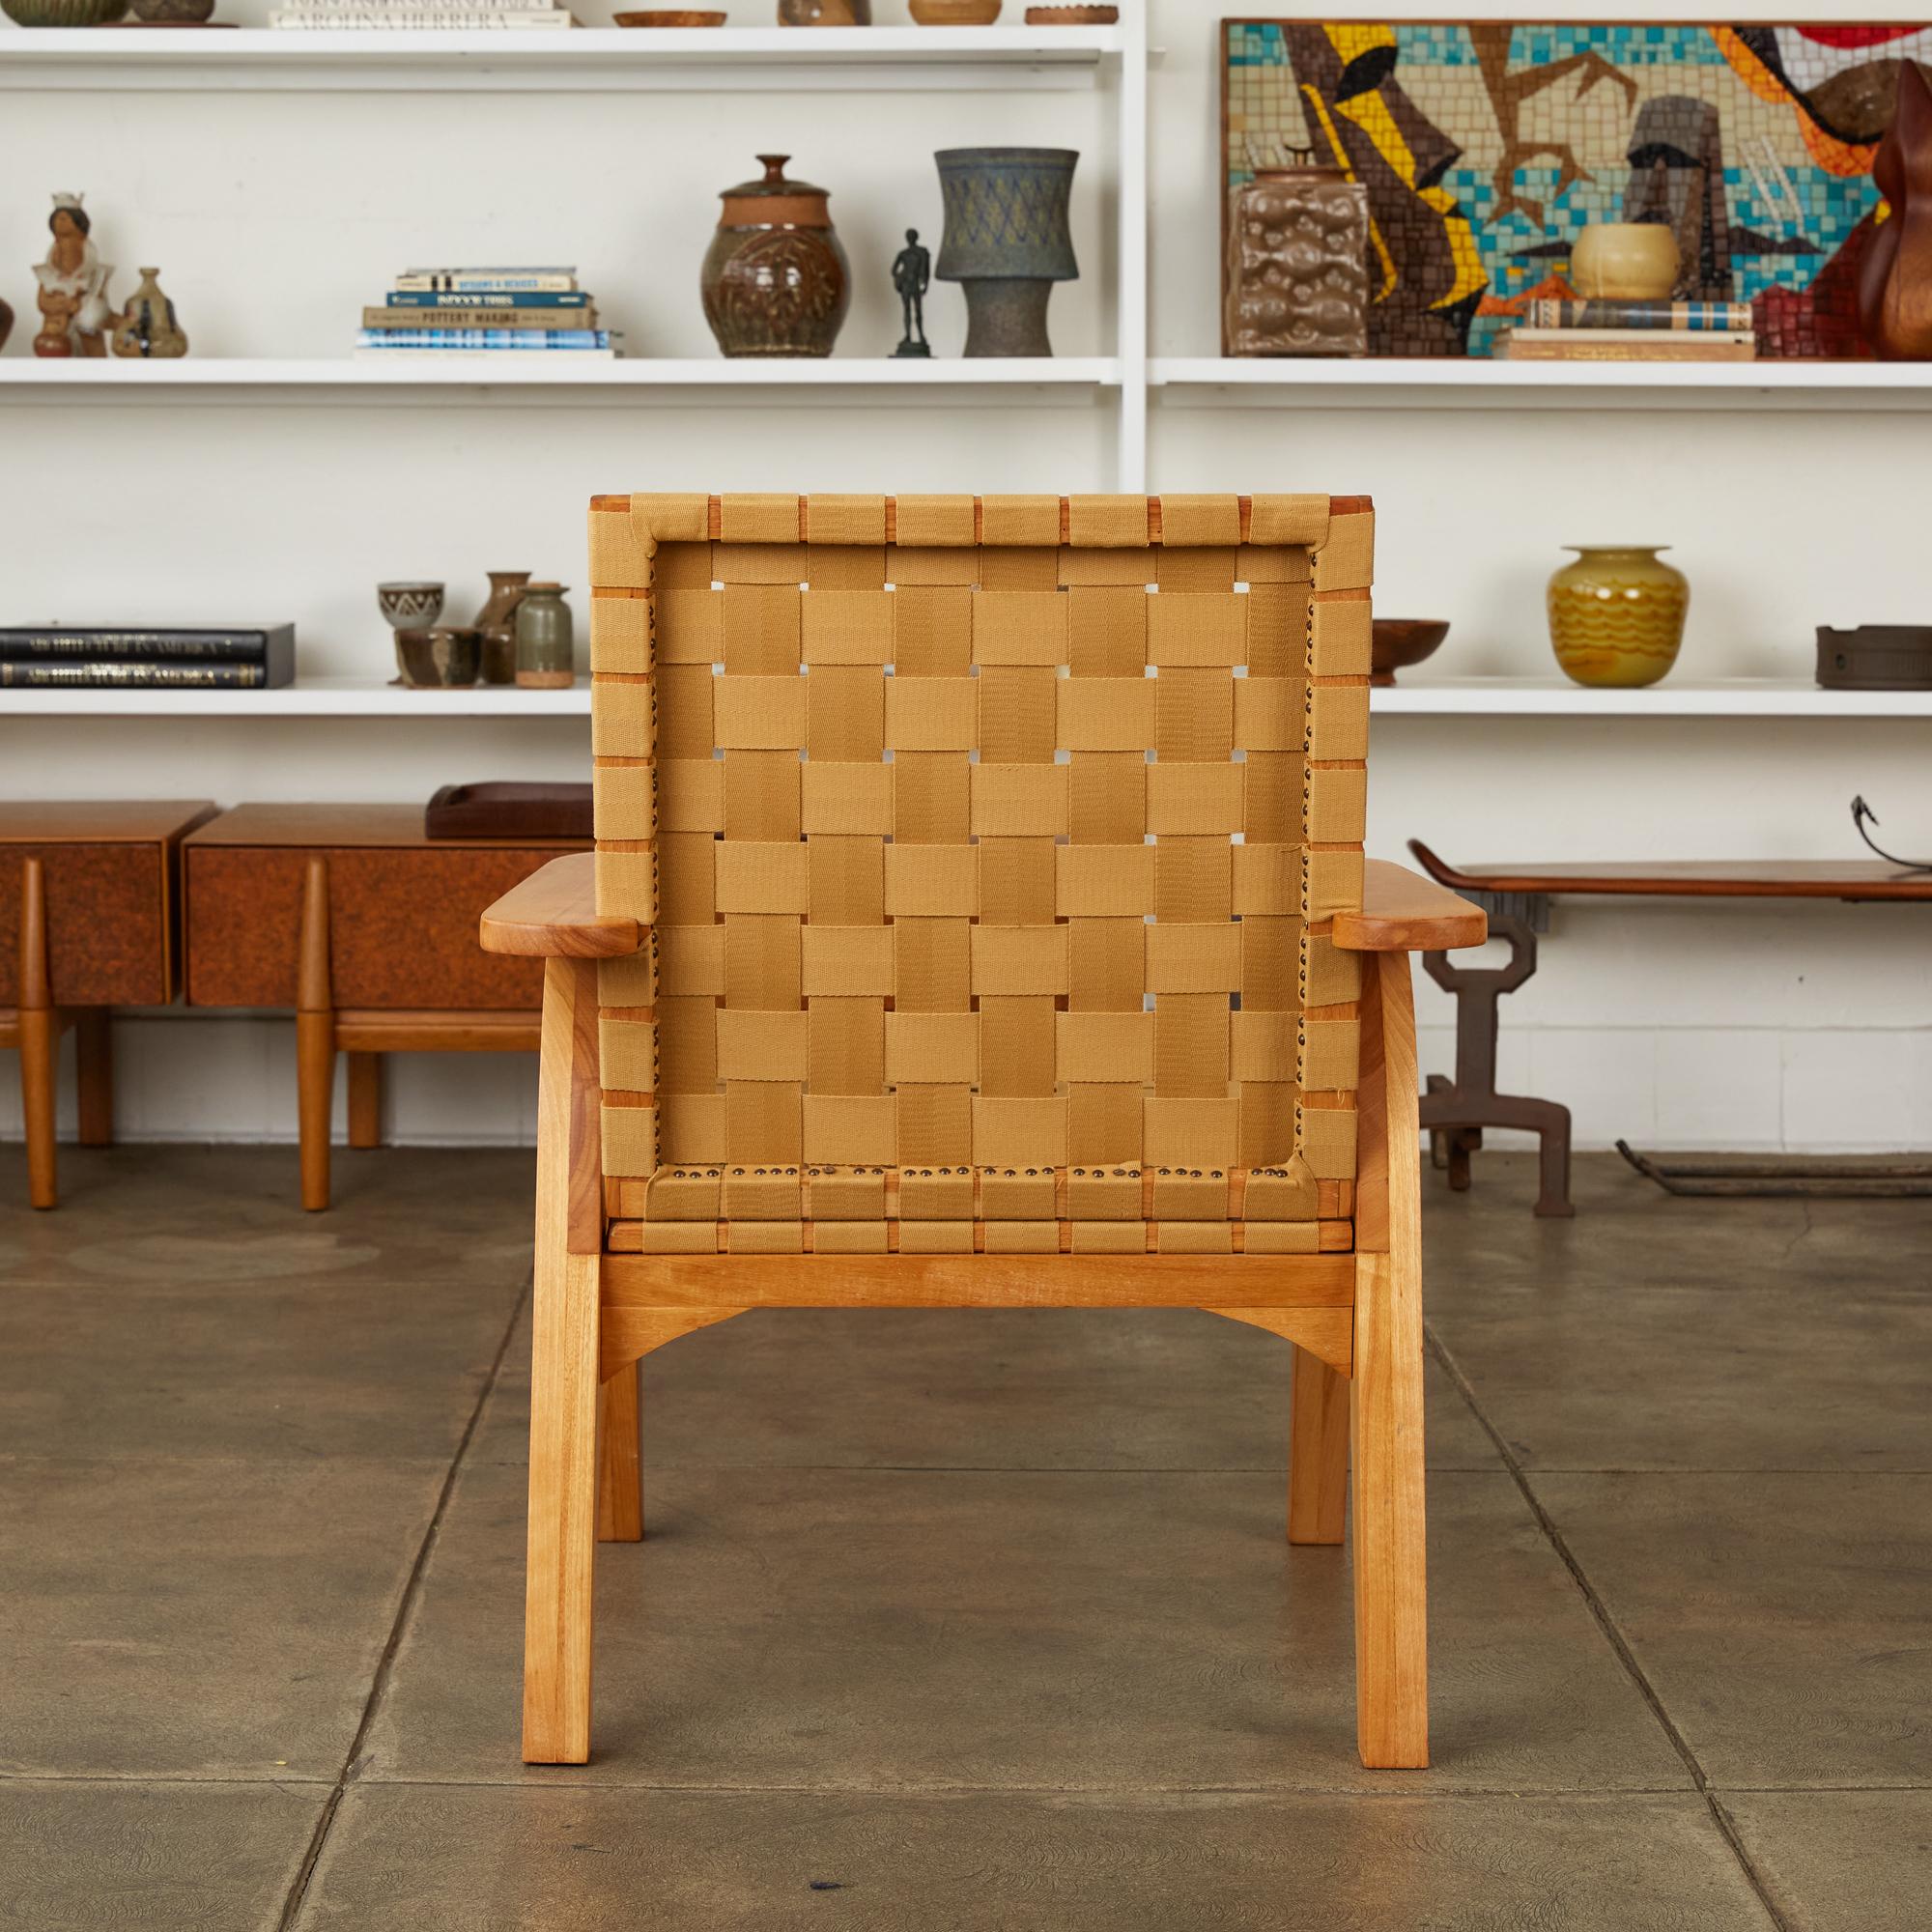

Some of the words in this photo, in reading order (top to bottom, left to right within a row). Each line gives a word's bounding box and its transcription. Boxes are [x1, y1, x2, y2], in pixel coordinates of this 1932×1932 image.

[277, 13, 394, 30] CAROLINA
[401, 13, 509, 30] HERRERA
[422, 312, 469, 323] POTTERY
[475, 313, 518, 324] MAKING
